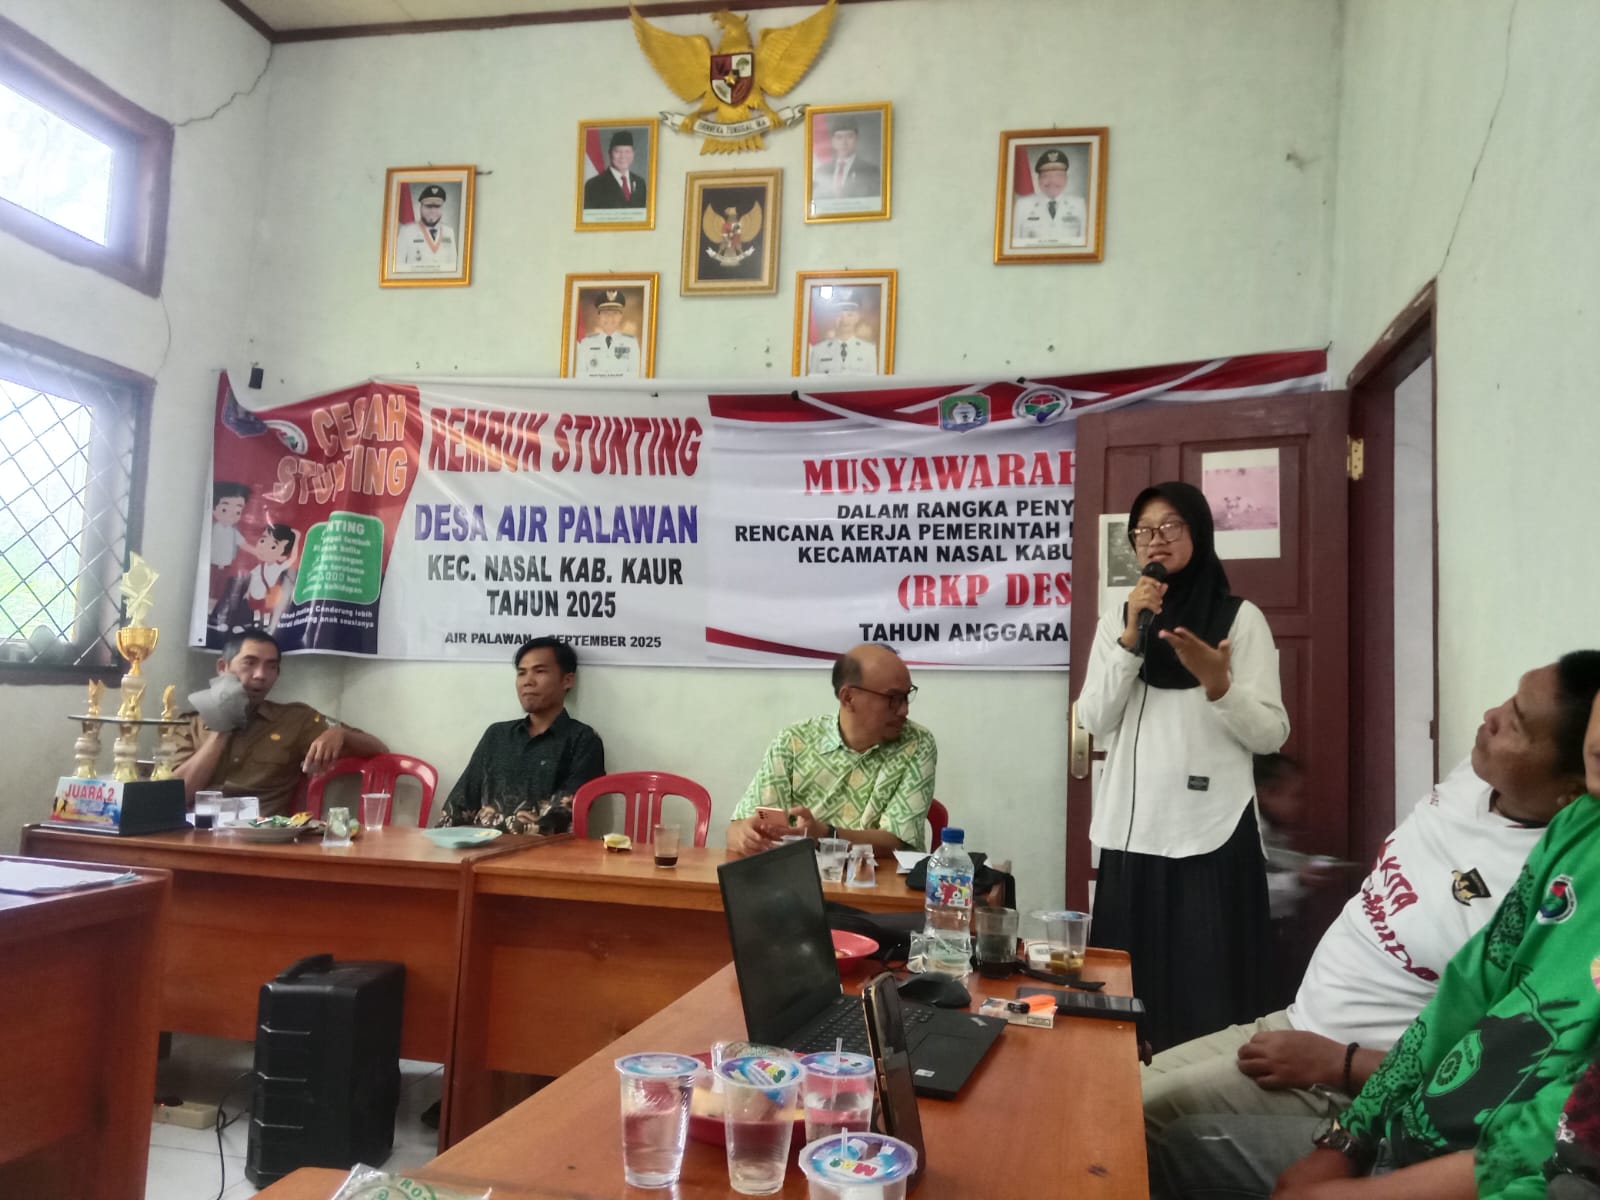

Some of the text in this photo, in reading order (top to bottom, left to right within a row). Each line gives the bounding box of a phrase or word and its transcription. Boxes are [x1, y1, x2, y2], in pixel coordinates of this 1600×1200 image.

[428, 407, 703, 476] REMBUK STUNTING
[837, 504, 908, 519] DALAM
[917, 500, 1008, 518] RANGKA
[414, 503, 698, 544] DESA AIR PALAWAN
[735, 525, 834, 541] RENCANA
[841, 524, 911, 541] KERJA
[919, 522, 1060, 540] PEMERINTAH
[798, 546, 928, 563] KECAMATAN
[936, 545, 1007, 563] NASAL
[428, 554, 683, 584] KEC. NASAL KAB. KAUR
[897, 574, 989, 611] (RKP
[486, 589, 616, 618] TAHUN 2025
[445, 632, 467, 643] AIR
[471, 632, 532, 645] PALAWAN
[630, 636, 662, 648] 2025
[859, 622, 1069, 642] TAHUN ANGGARA
[65, 783, 115, 802] JUARA 2
